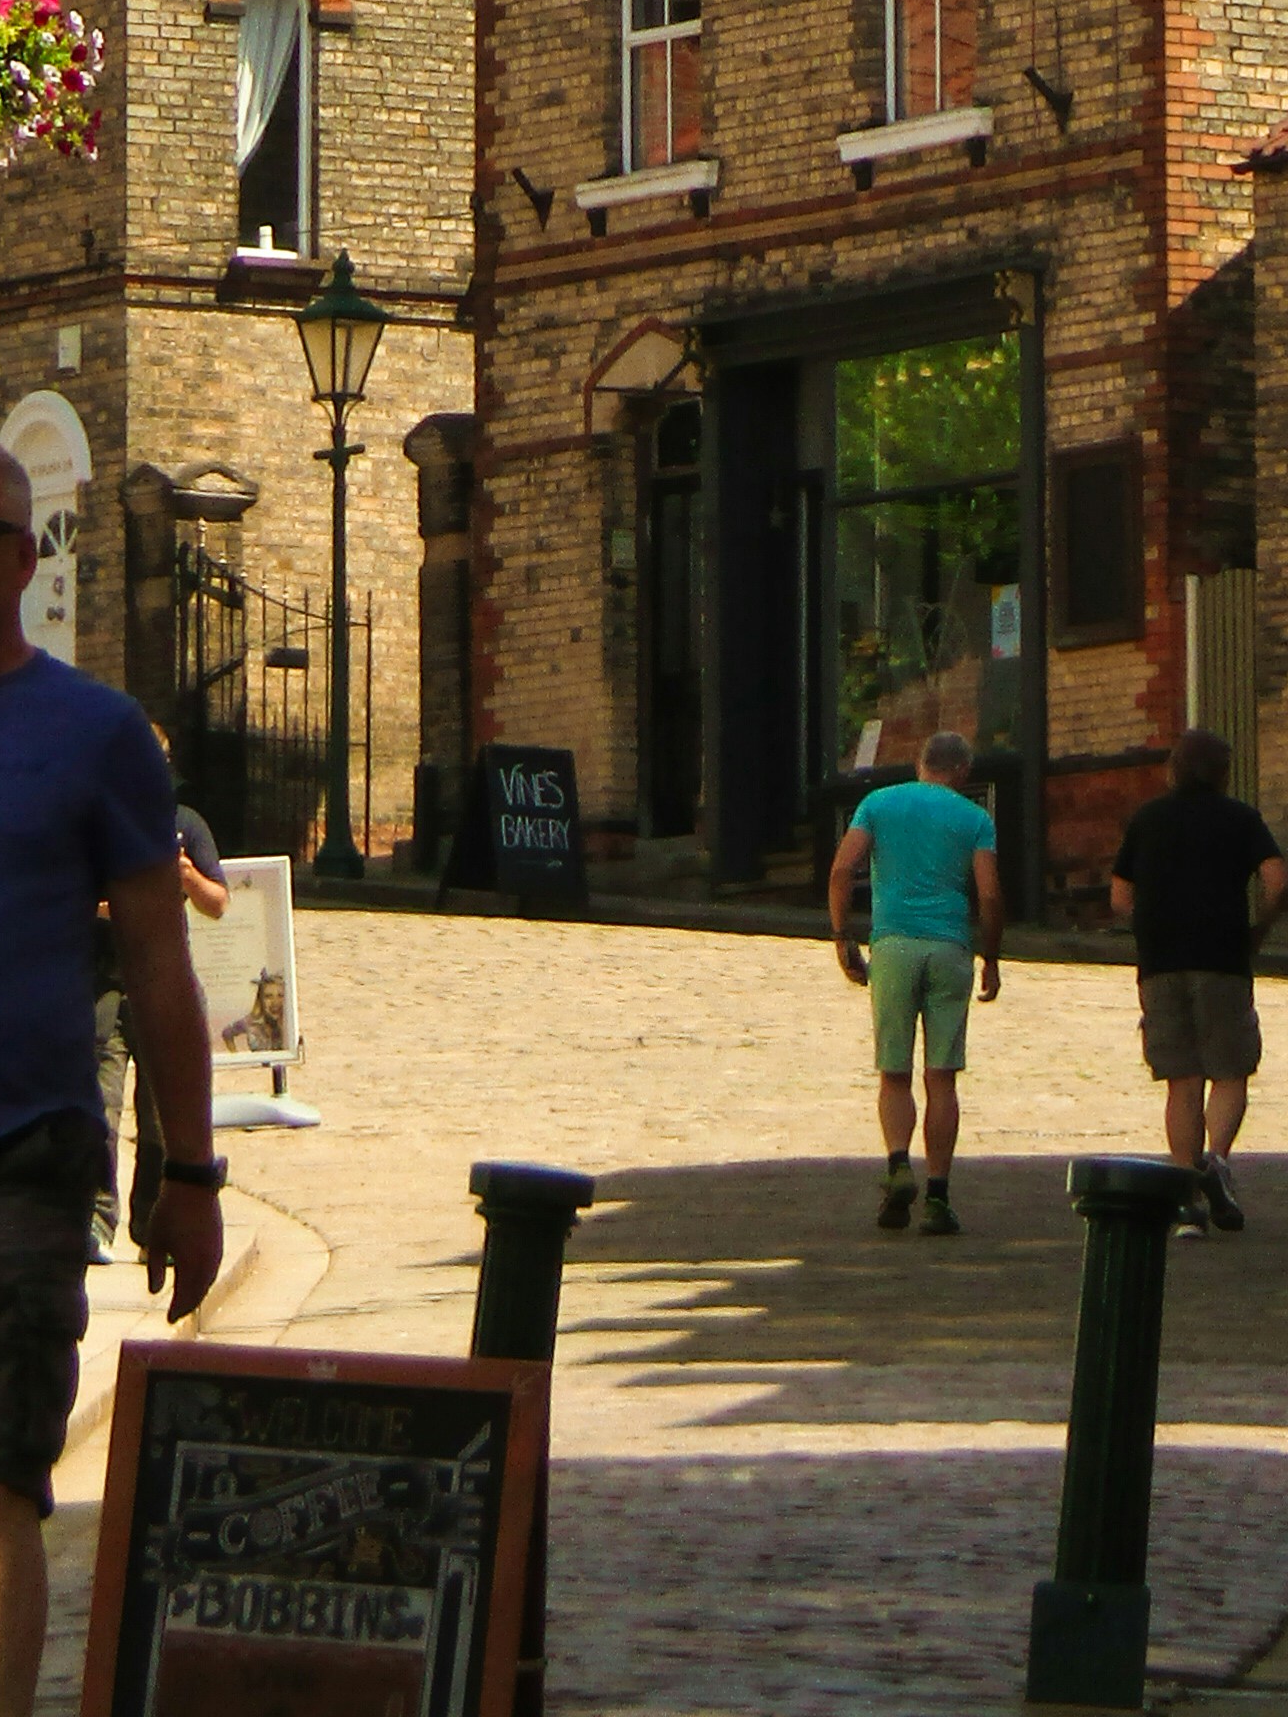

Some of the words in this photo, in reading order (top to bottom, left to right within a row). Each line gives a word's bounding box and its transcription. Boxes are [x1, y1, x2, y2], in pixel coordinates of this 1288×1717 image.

[499, 763, 564, 809] VINES
[500, 813, 571, 850] BAKERY
[218, 1469, 383, 1555] COFFEE
[196, 1575, 410, 1639] BOBBINS
